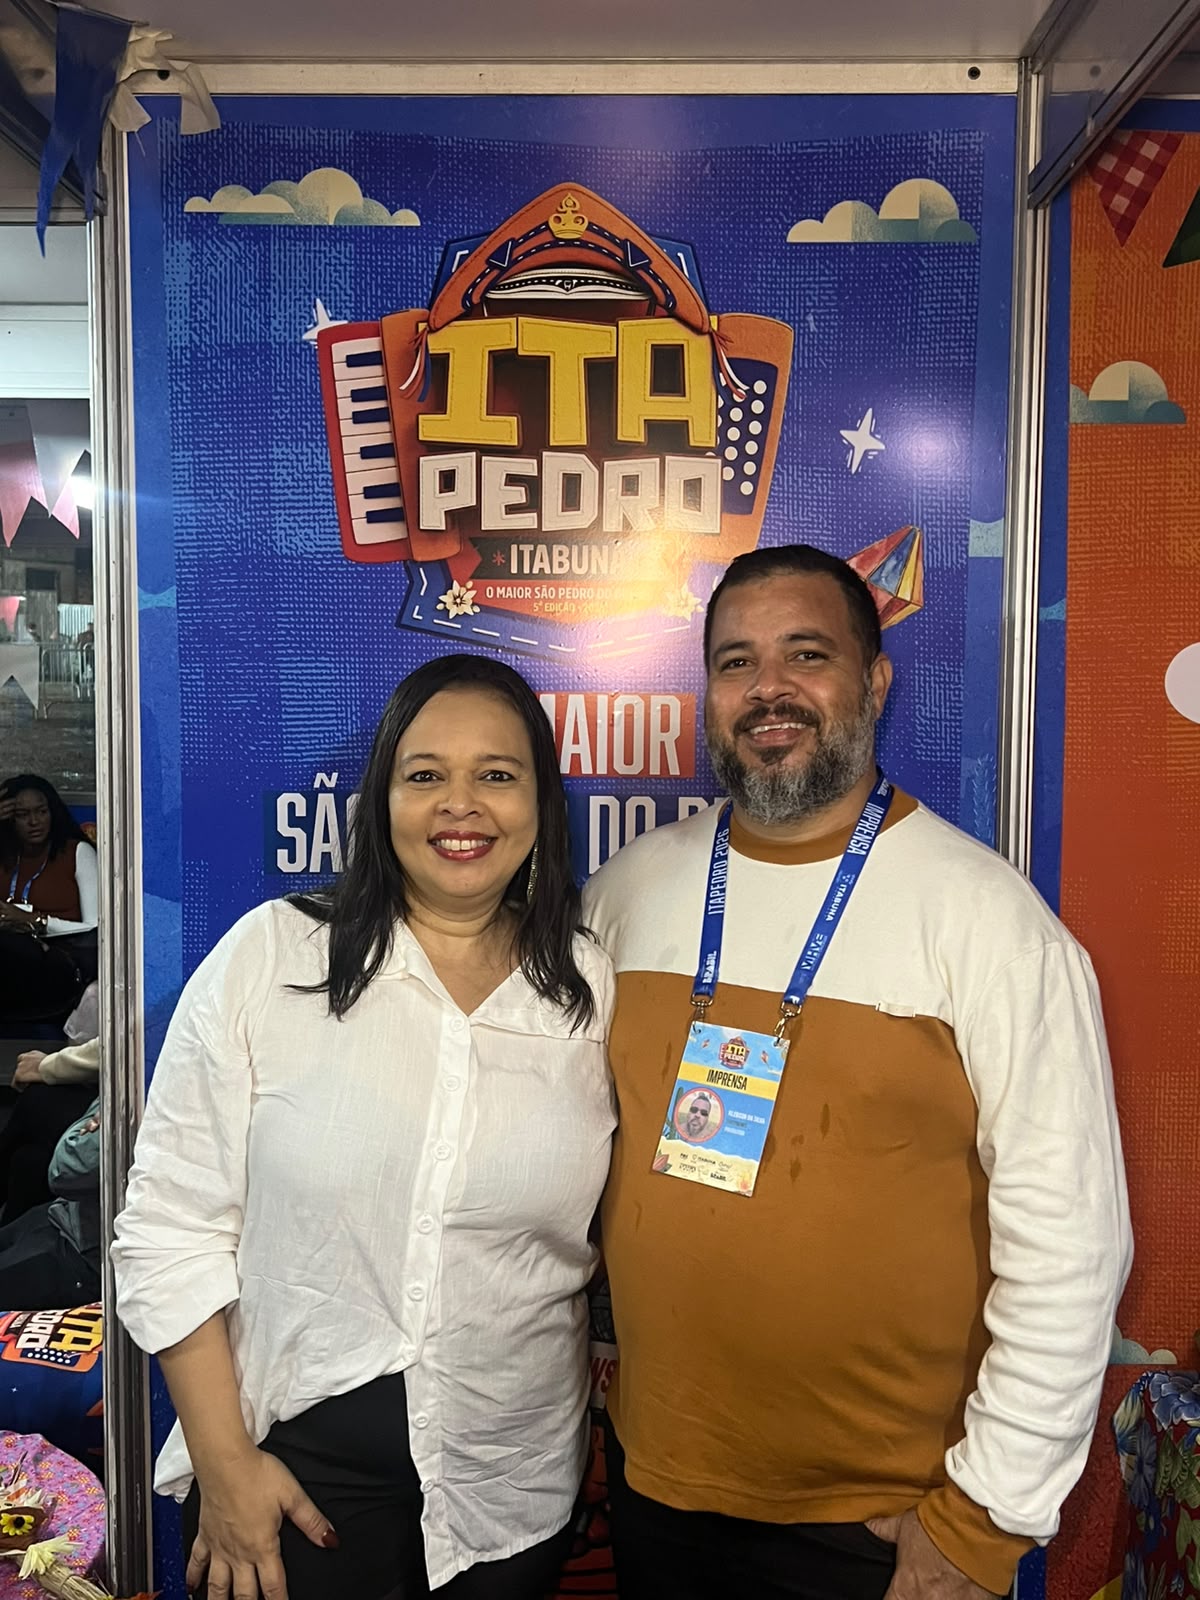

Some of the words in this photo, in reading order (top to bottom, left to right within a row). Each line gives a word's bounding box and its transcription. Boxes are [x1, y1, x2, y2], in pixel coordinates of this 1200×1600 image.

[418, 315, 718, 447] ITA
[419, 451, 722, 533] PEDRO
[486, 587, 494, 599] O
[496, 587, 532, 599] MAIOR
[534, 584, 556, 599] SÃO
[558, 587, 595, 600] PEDRO
[276, 772, 360, 873] SÃ
[715, 828, 730, 858] 2026
[847, 802, 885, 856] IMPRENSA
[708, 860, 728, 915] ITAPEDRO
[706, 1069, 748, 1091] IMPRENSA
